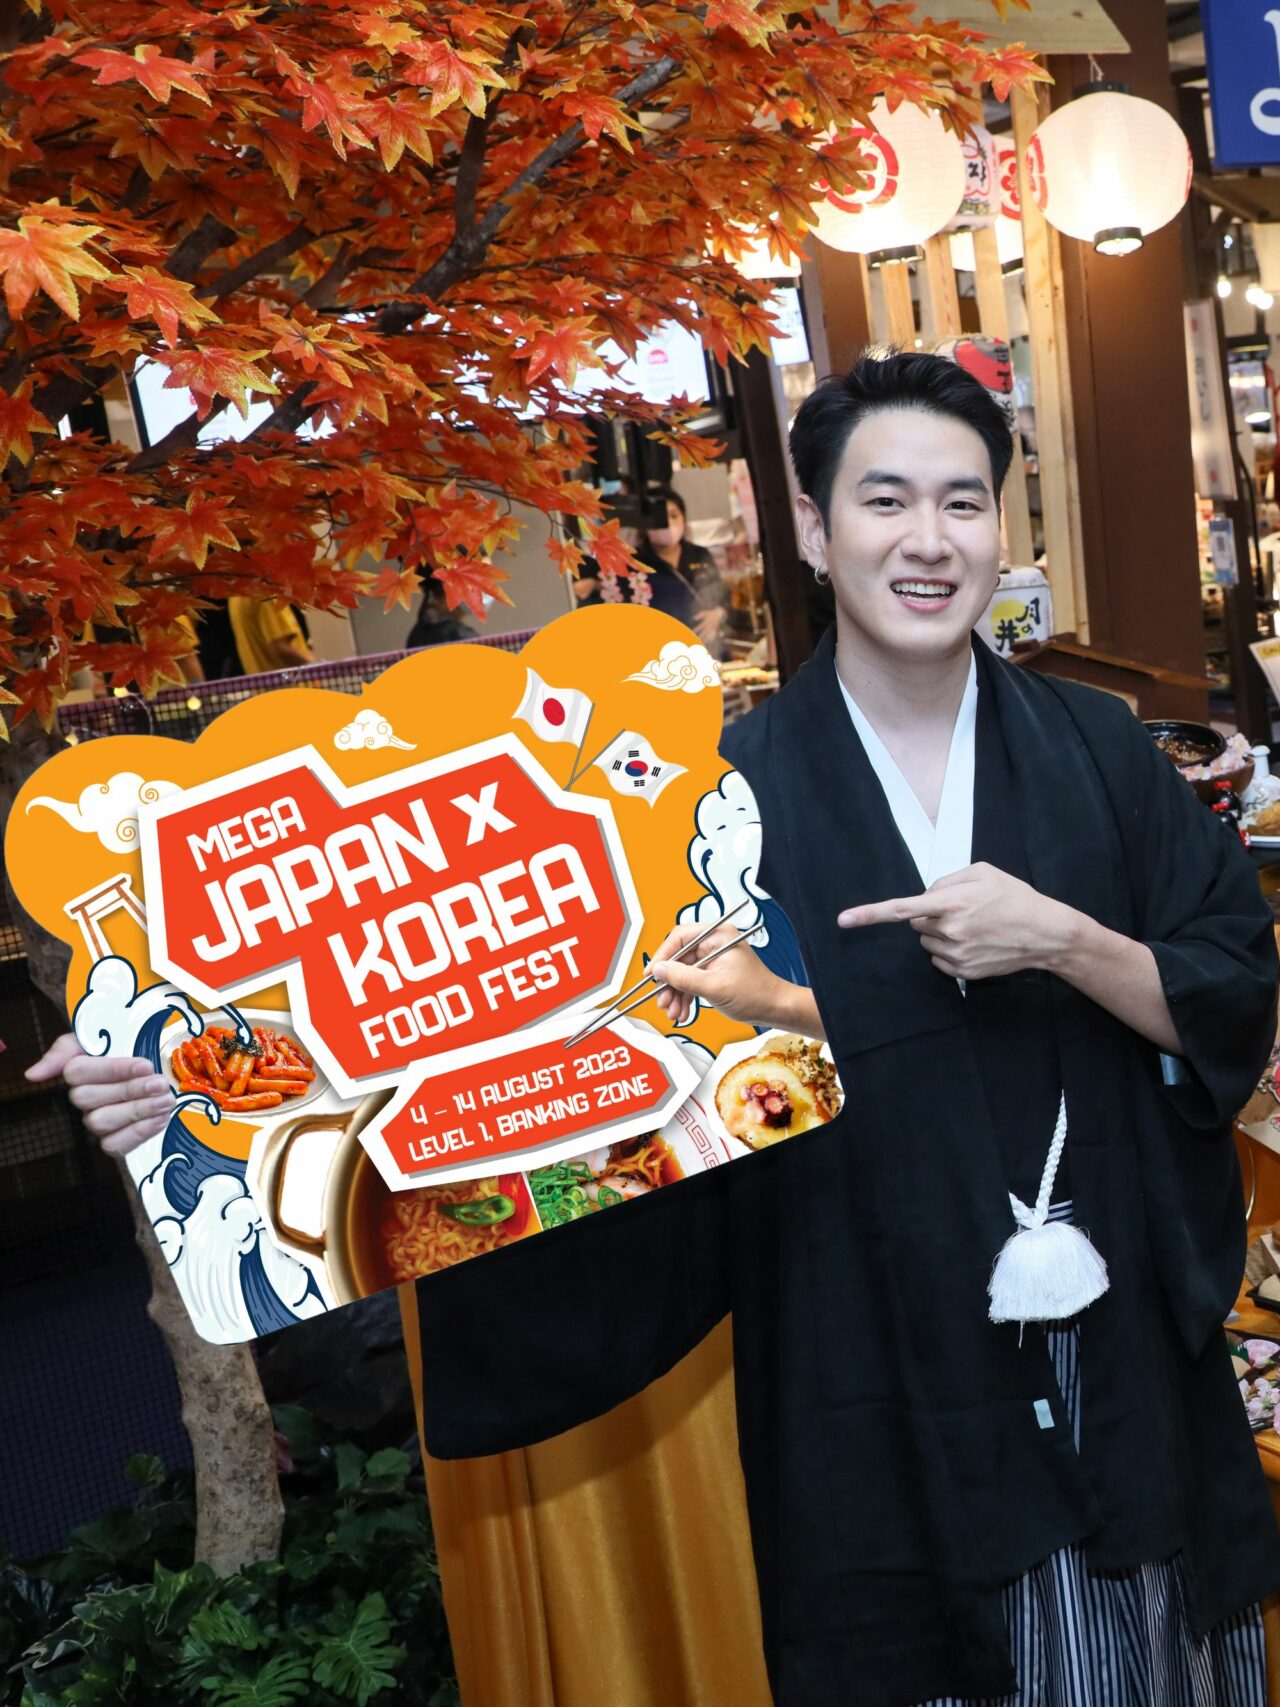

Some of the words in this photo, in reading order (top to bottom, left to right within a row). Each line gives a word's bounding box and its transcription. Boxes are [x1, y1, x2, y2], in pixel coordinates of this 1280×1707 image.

[186, 796, 307, 873] MEGA
[191, 798, 450, 962] JAPAN
[326, 843, 601, 1007] KOREA
[359, 984, 475, 1059] FOOD
[478, 936, 581, 1011] FEST
[408, 1127, 475, 1162] LEVEL
[477, 1122, 494, 1143] 1,
[496, 1092, 590, 1137] BANKING
[593, 1074, 653, 1108] ZONE
[410, 1104, 429, 1125] 4
[452, 1090, 477, 1115] 14
[480, 1063, 566, 1107] AUGUST
[573, 1046, 631, 1079] 2023
